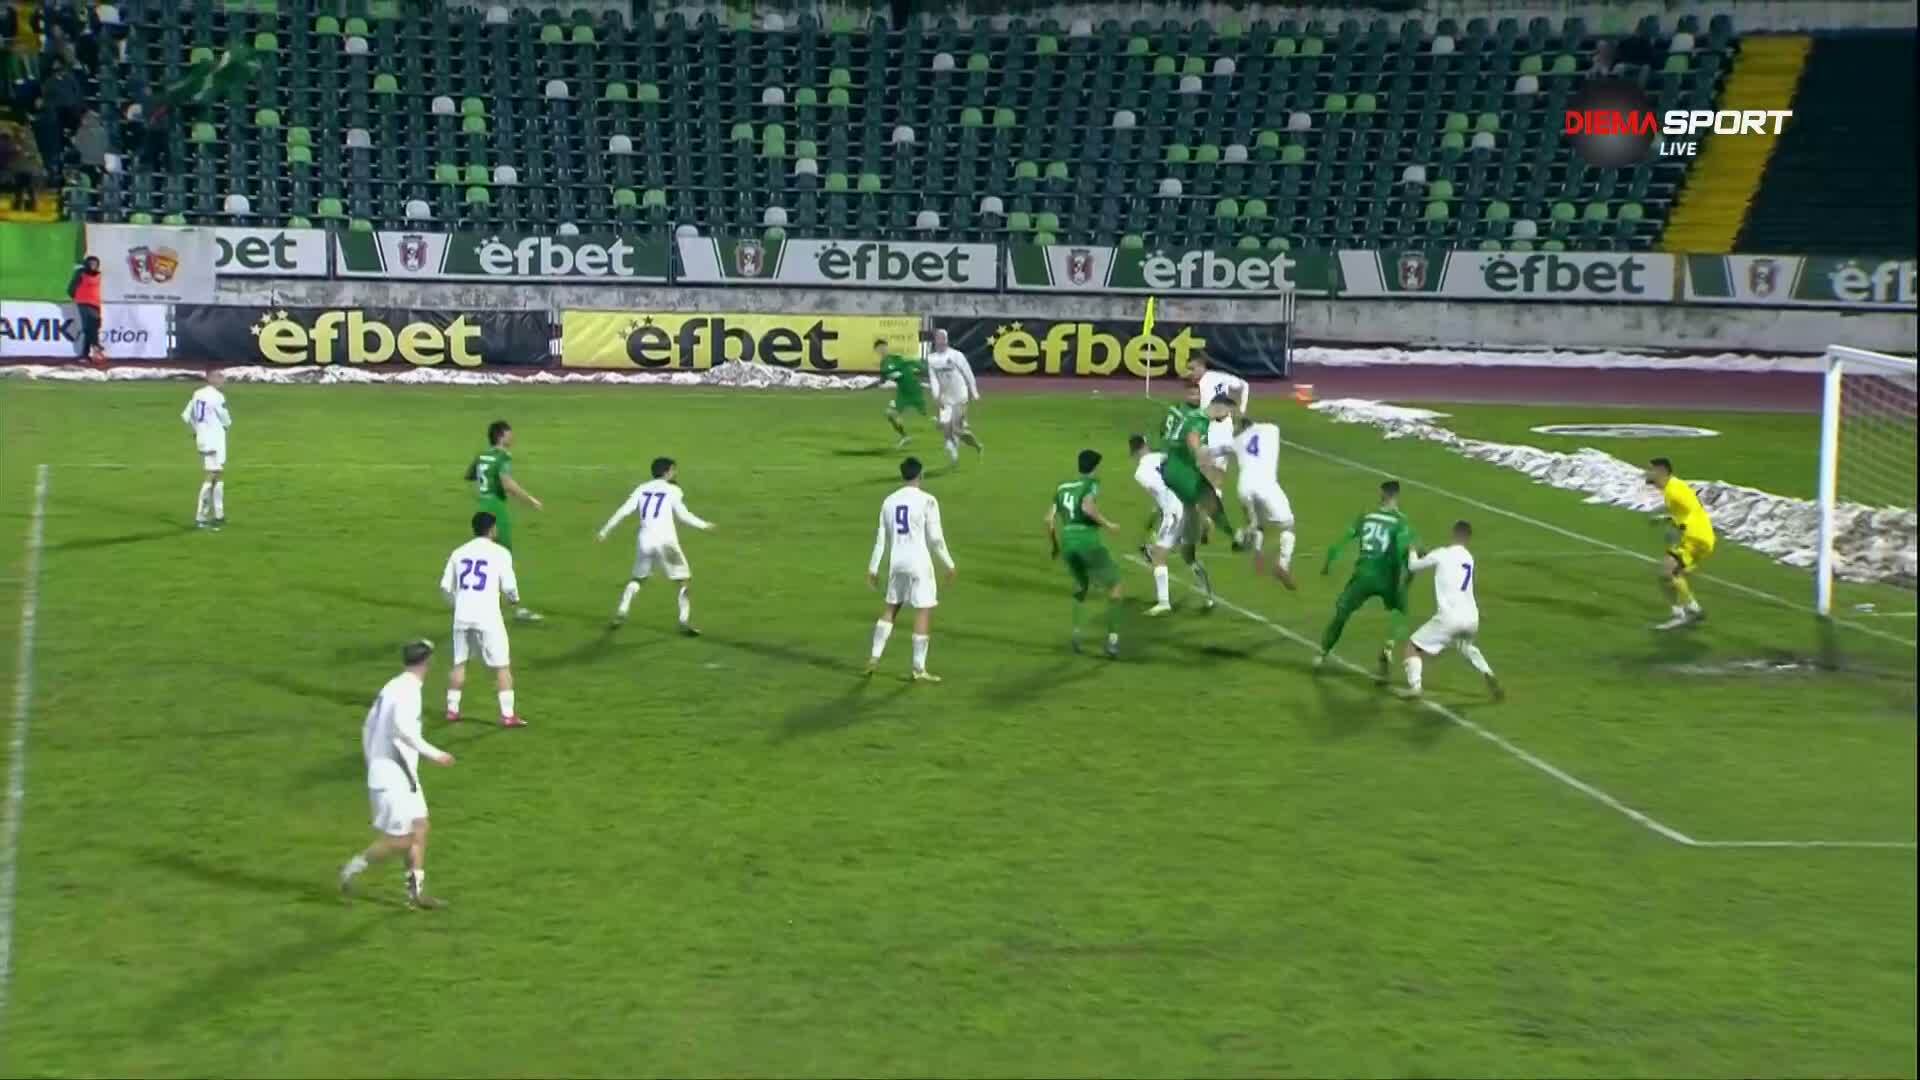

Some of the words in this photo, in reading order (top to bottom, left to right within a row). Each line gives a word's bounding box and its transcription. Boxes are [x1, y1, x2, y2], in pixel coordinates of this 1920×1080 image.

[479, 236, 634, 276] efbet
[818, 243, 969, 283] efbet
[1143, 250, 1296, 290] efbet
[1484, 254, 1646, 294] efbet
[258, 310, 483, 367] efbet
[992, 323, 1206, 378] efbet
[1246, 433, 1260, 457] 4
[642, 491, 667, 519] 77
[895, 504, 910, 535] 9
[1062, 491, 1075, 520] 4
[1361, 521, 1390, 553] 24
[459, 558, 488, 591] 25
[1460, 563, 1472, 592] 7
